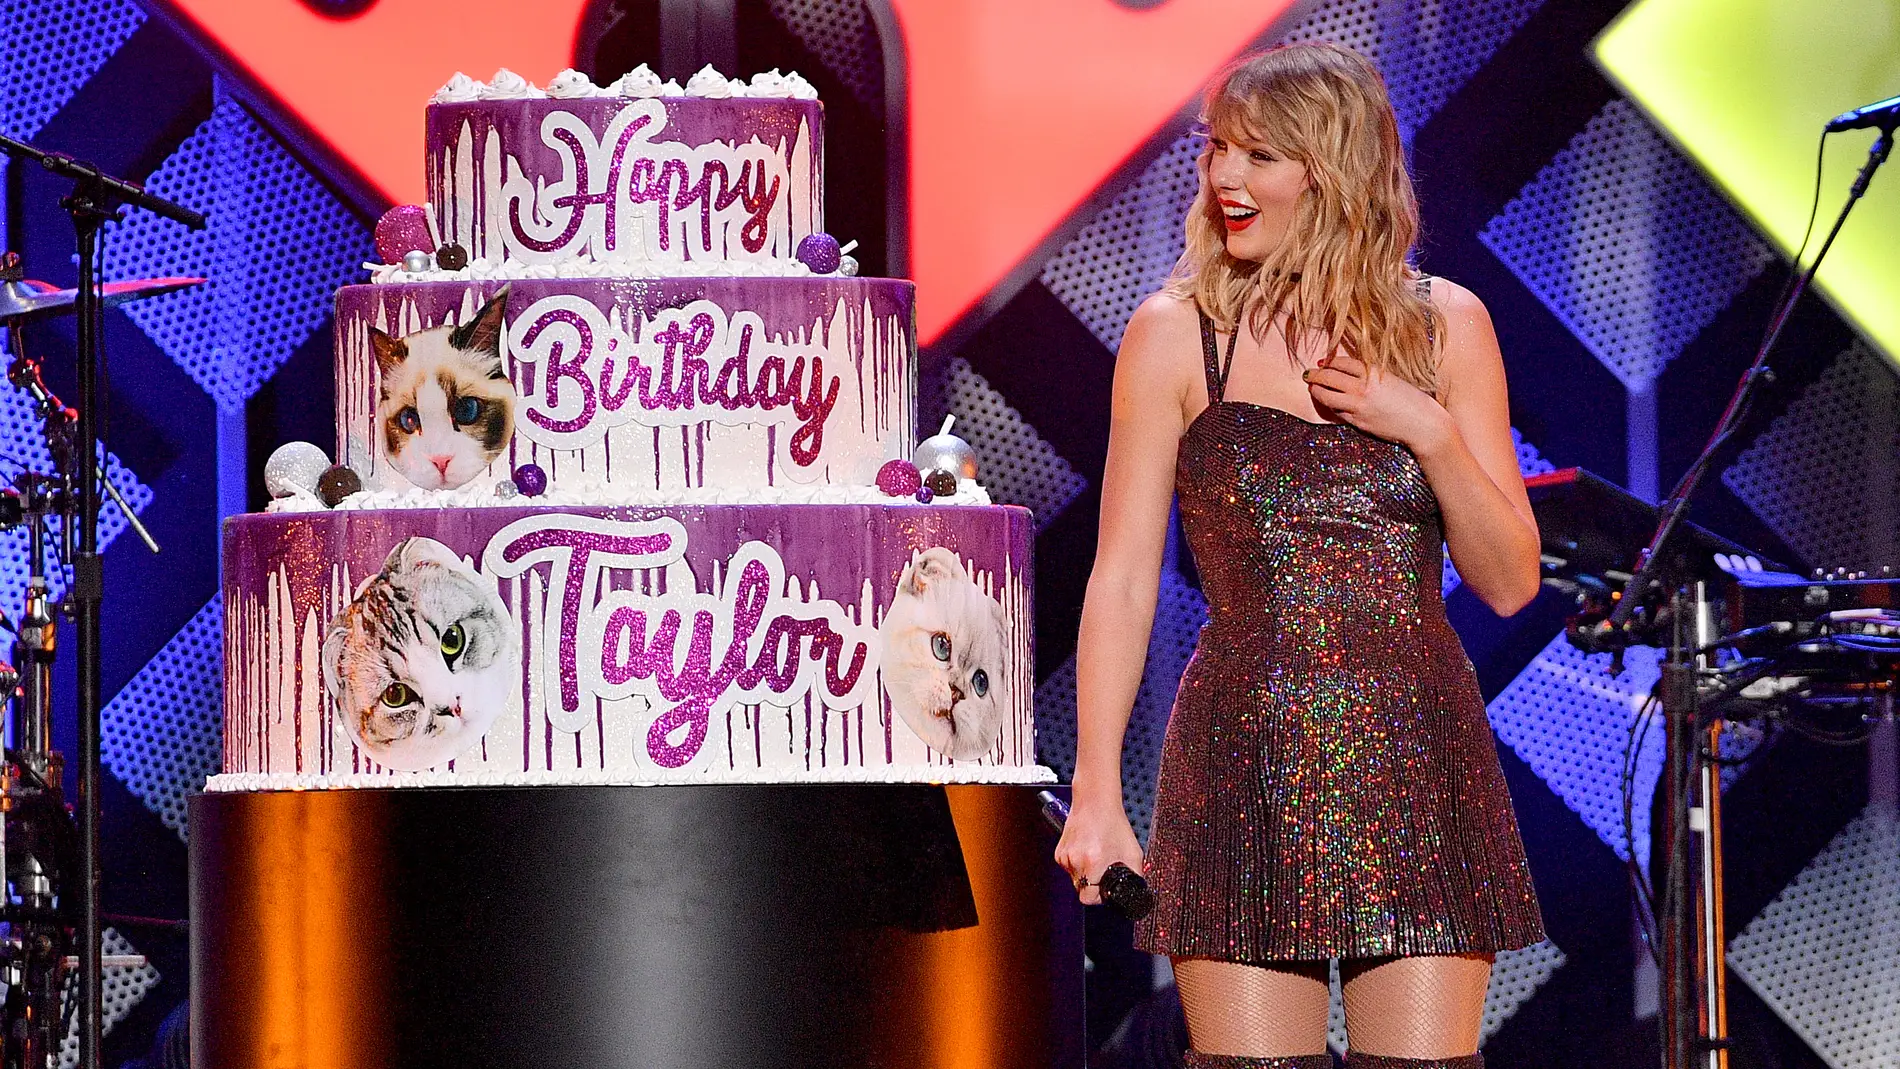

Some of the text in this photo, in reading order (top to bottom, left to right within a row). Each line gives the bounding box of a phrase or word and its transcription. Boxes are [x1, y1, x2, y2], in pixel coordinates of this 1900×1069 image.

[508, 114, 780, 253] Happy
[521, 308, 841, 467] Birthday
[502, 528, 867, 769] Taylor
